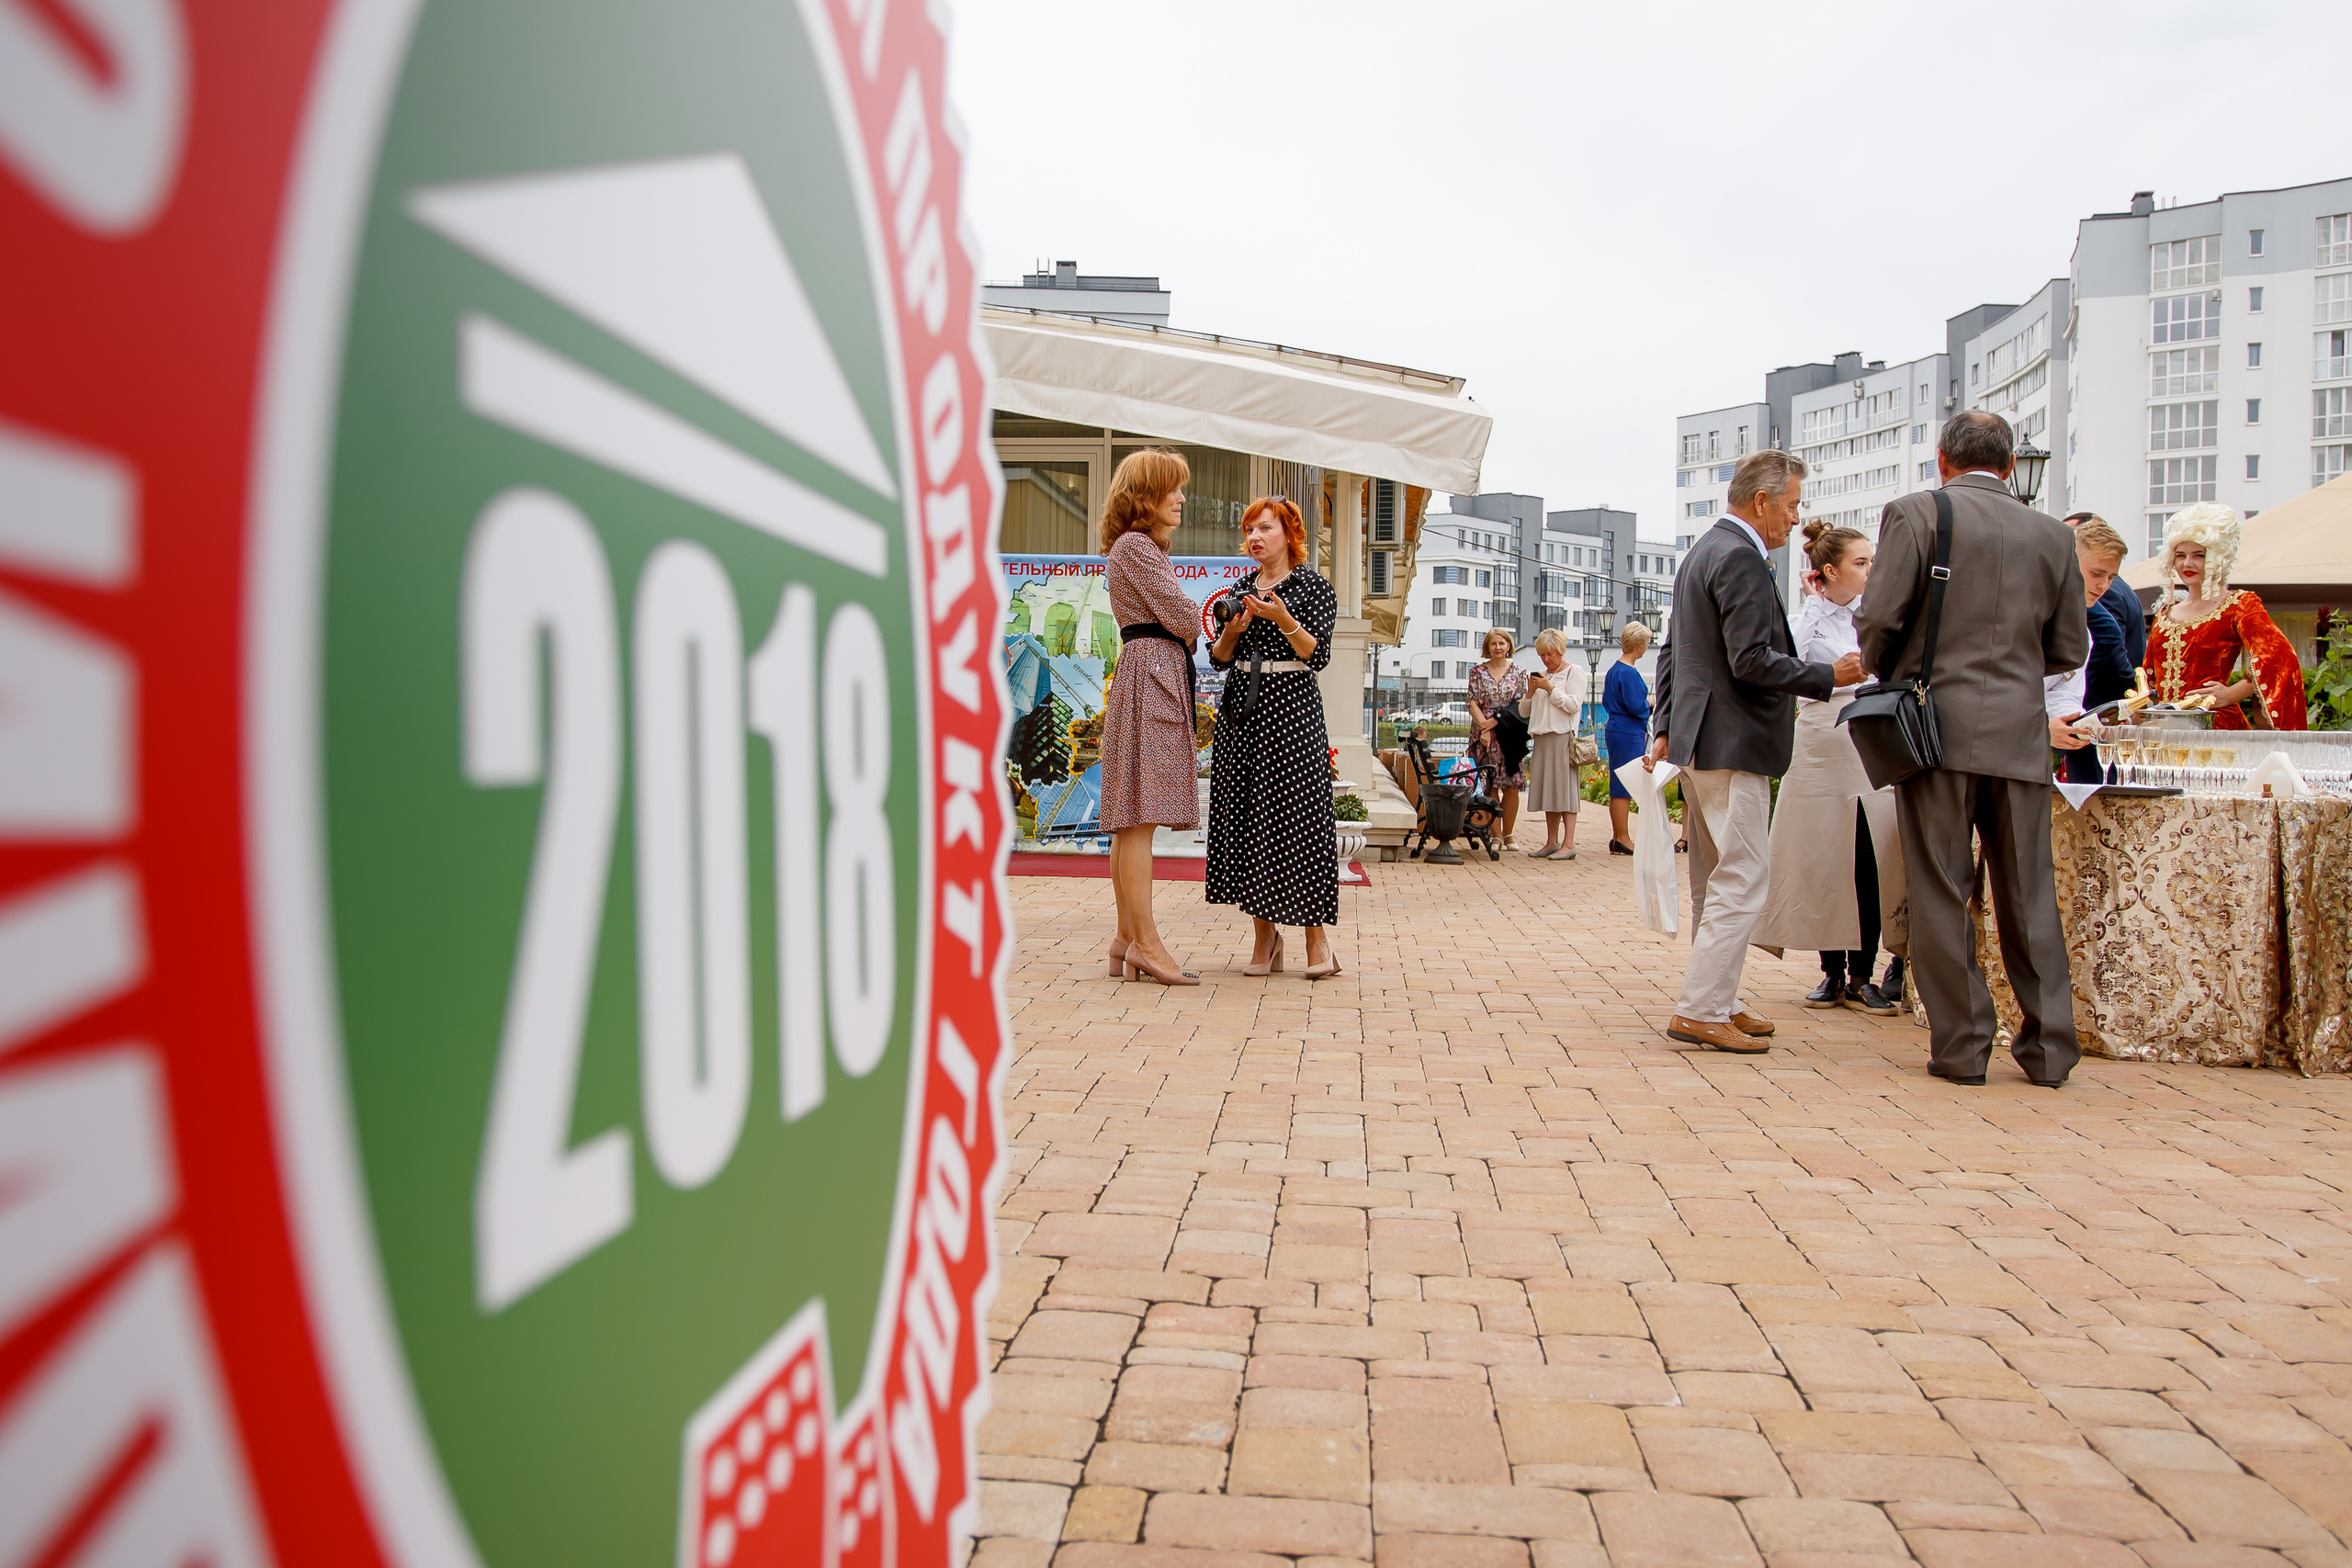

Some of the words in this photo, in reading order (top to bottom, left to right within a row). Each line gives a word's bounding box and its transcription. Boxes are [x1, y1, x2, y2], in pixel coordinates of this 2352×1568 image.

[882, 64, 984, 978] ПРОДУКТ
[1001, 561, 1080, 577] ТЕЛЬНЫЙ
[1085, 563, 1105, 577] ПР
[1174, 565, 1208, 581] ОДА
[463, 485, 897, 1314] 2018
[891, 1014, 980, 1527] ГОДА
